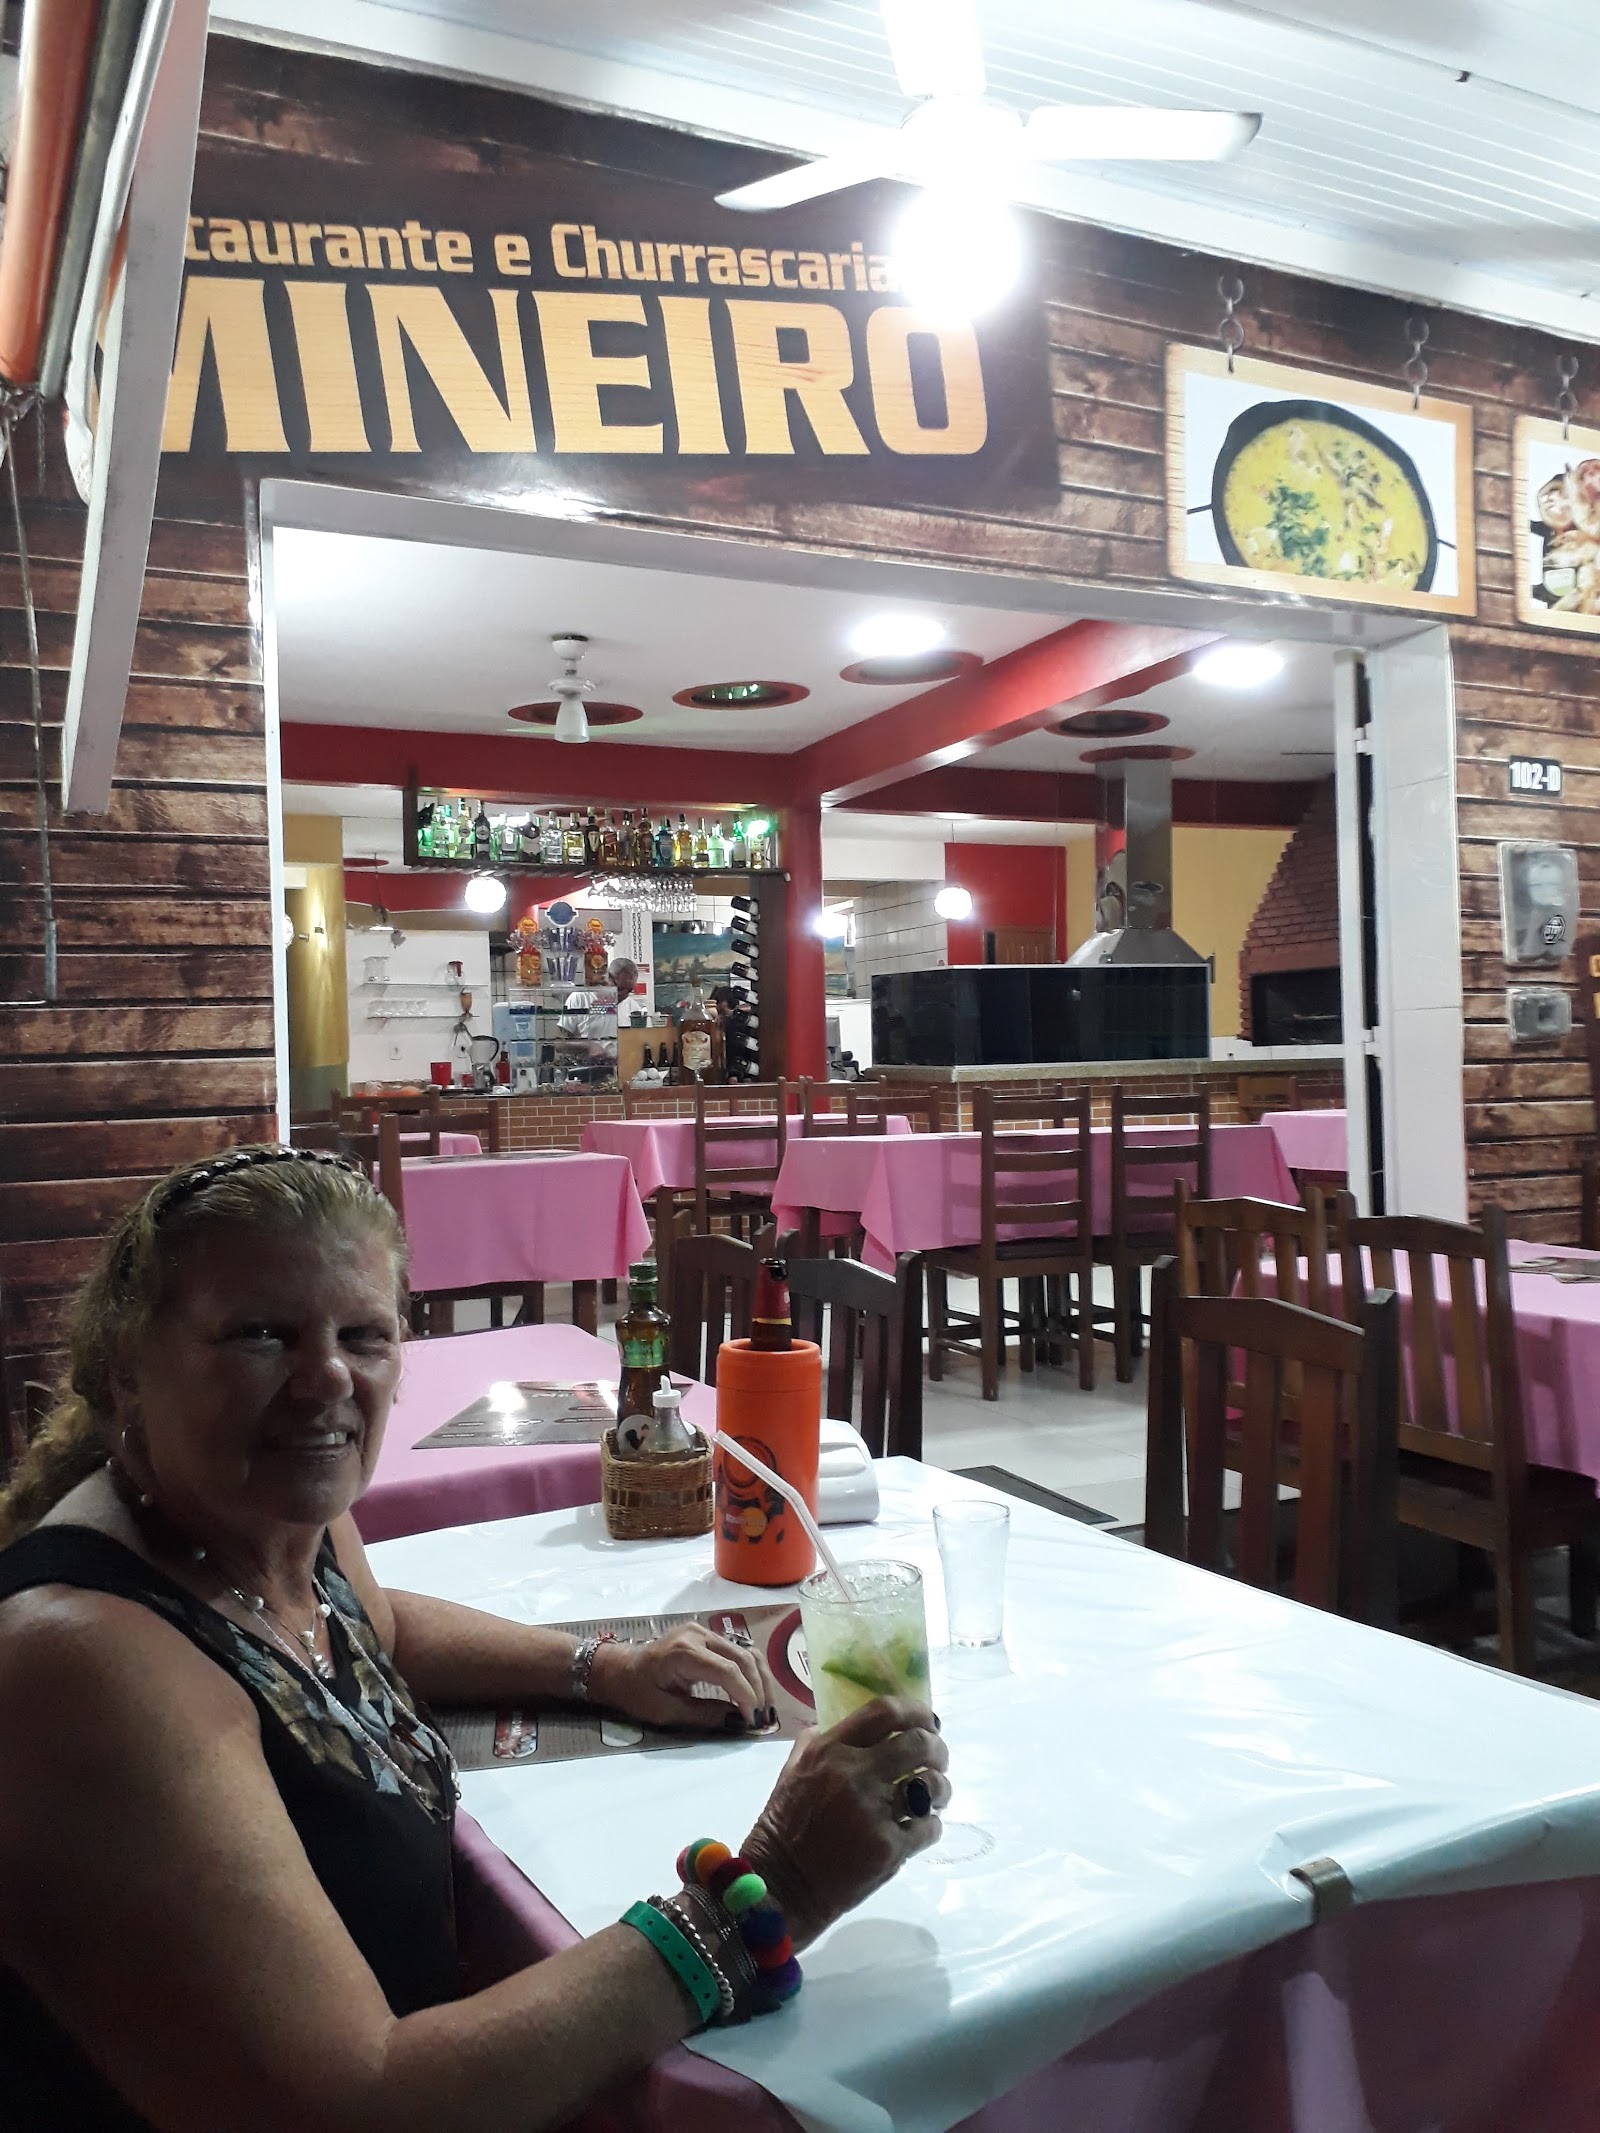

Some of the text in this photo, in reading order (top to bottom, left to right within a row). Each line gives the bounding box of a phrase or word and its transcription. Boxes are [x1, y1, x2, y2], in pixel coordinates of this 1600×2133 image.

[495, 231, 532, 275] e
[551, 223, 903, 293] Churrascaria
[1509, 761, 1561, 792] 102-D
